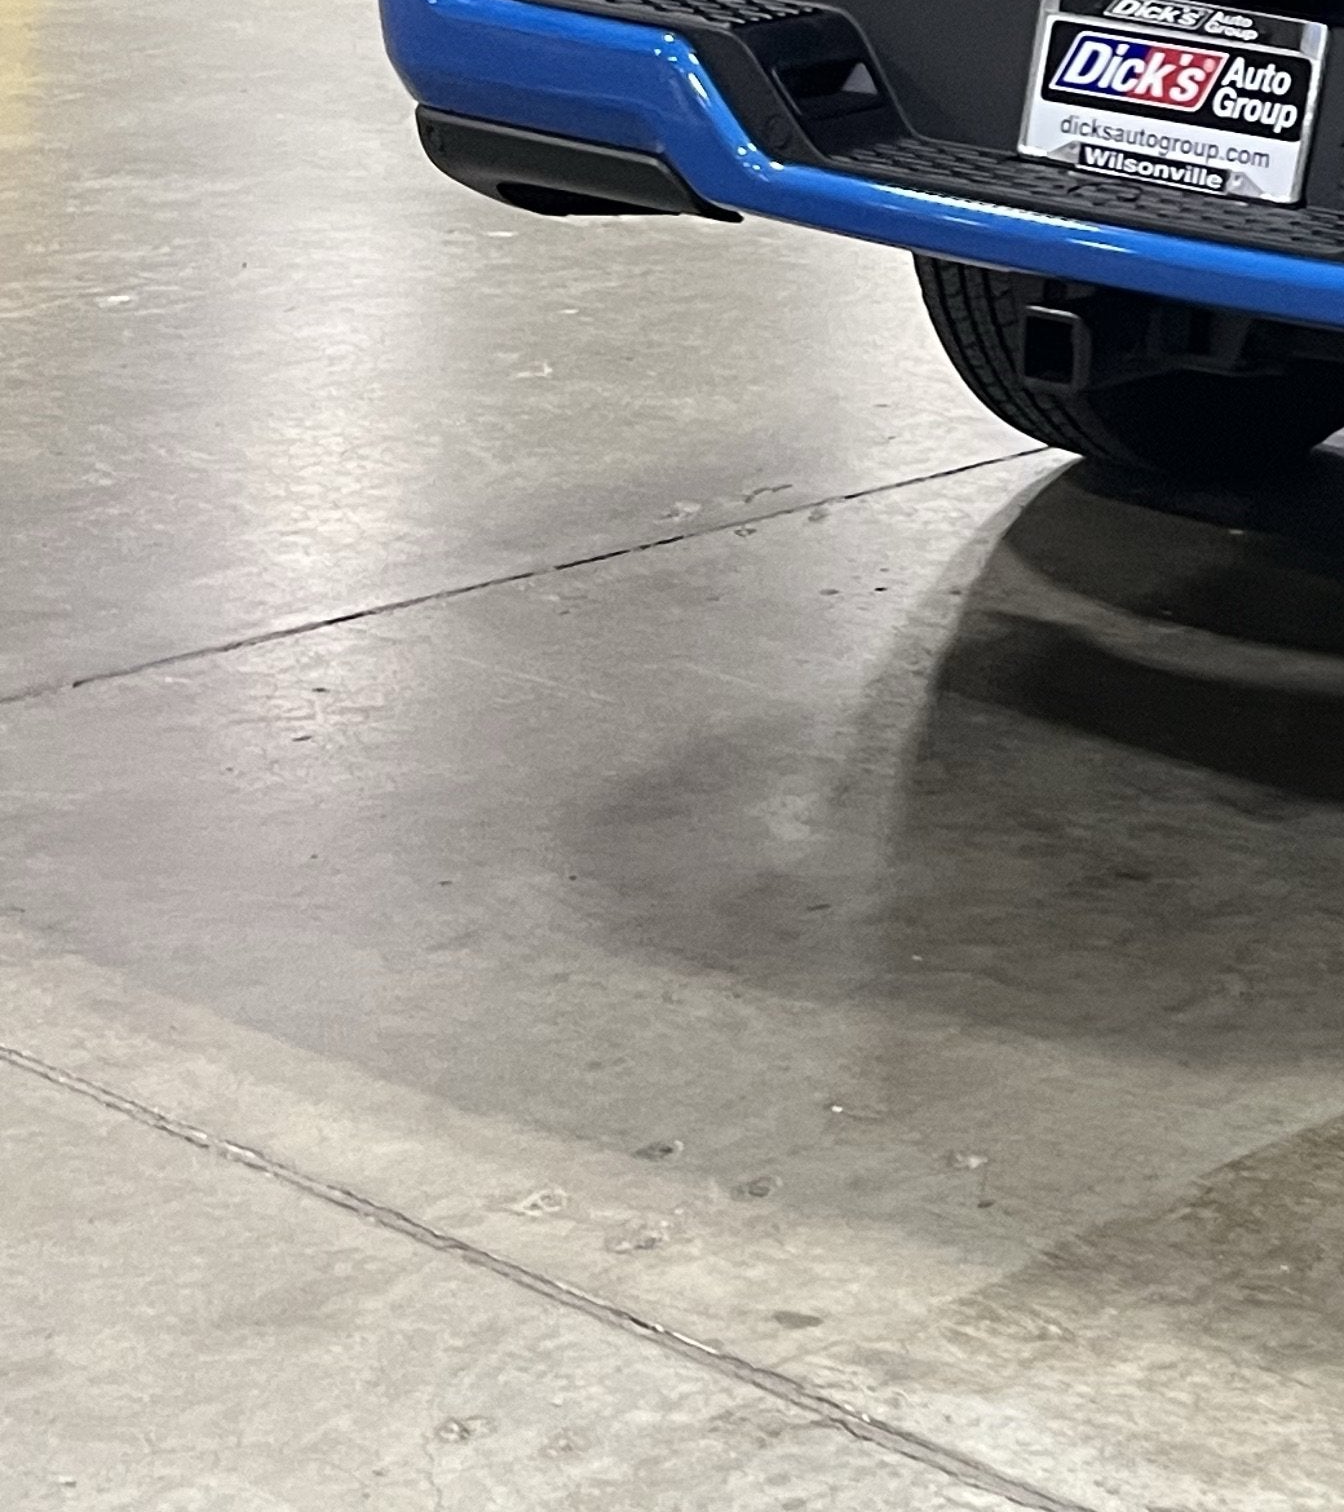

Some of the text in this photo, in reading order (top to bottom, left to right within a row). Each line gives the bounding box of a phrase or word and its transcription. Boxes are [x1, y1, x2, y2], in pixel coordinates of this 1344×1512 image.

[1211, 11, 1253, 28] Auto
[1063, 40, 1206, 102] Dick's
[1221, 56, 1292, 96] Auto
[1212, 86, 1298, 133] Group
[1060, 115, 1270, 168] dicksautogroup.com
[1084, 146, 1223, 189] Wilsonville
